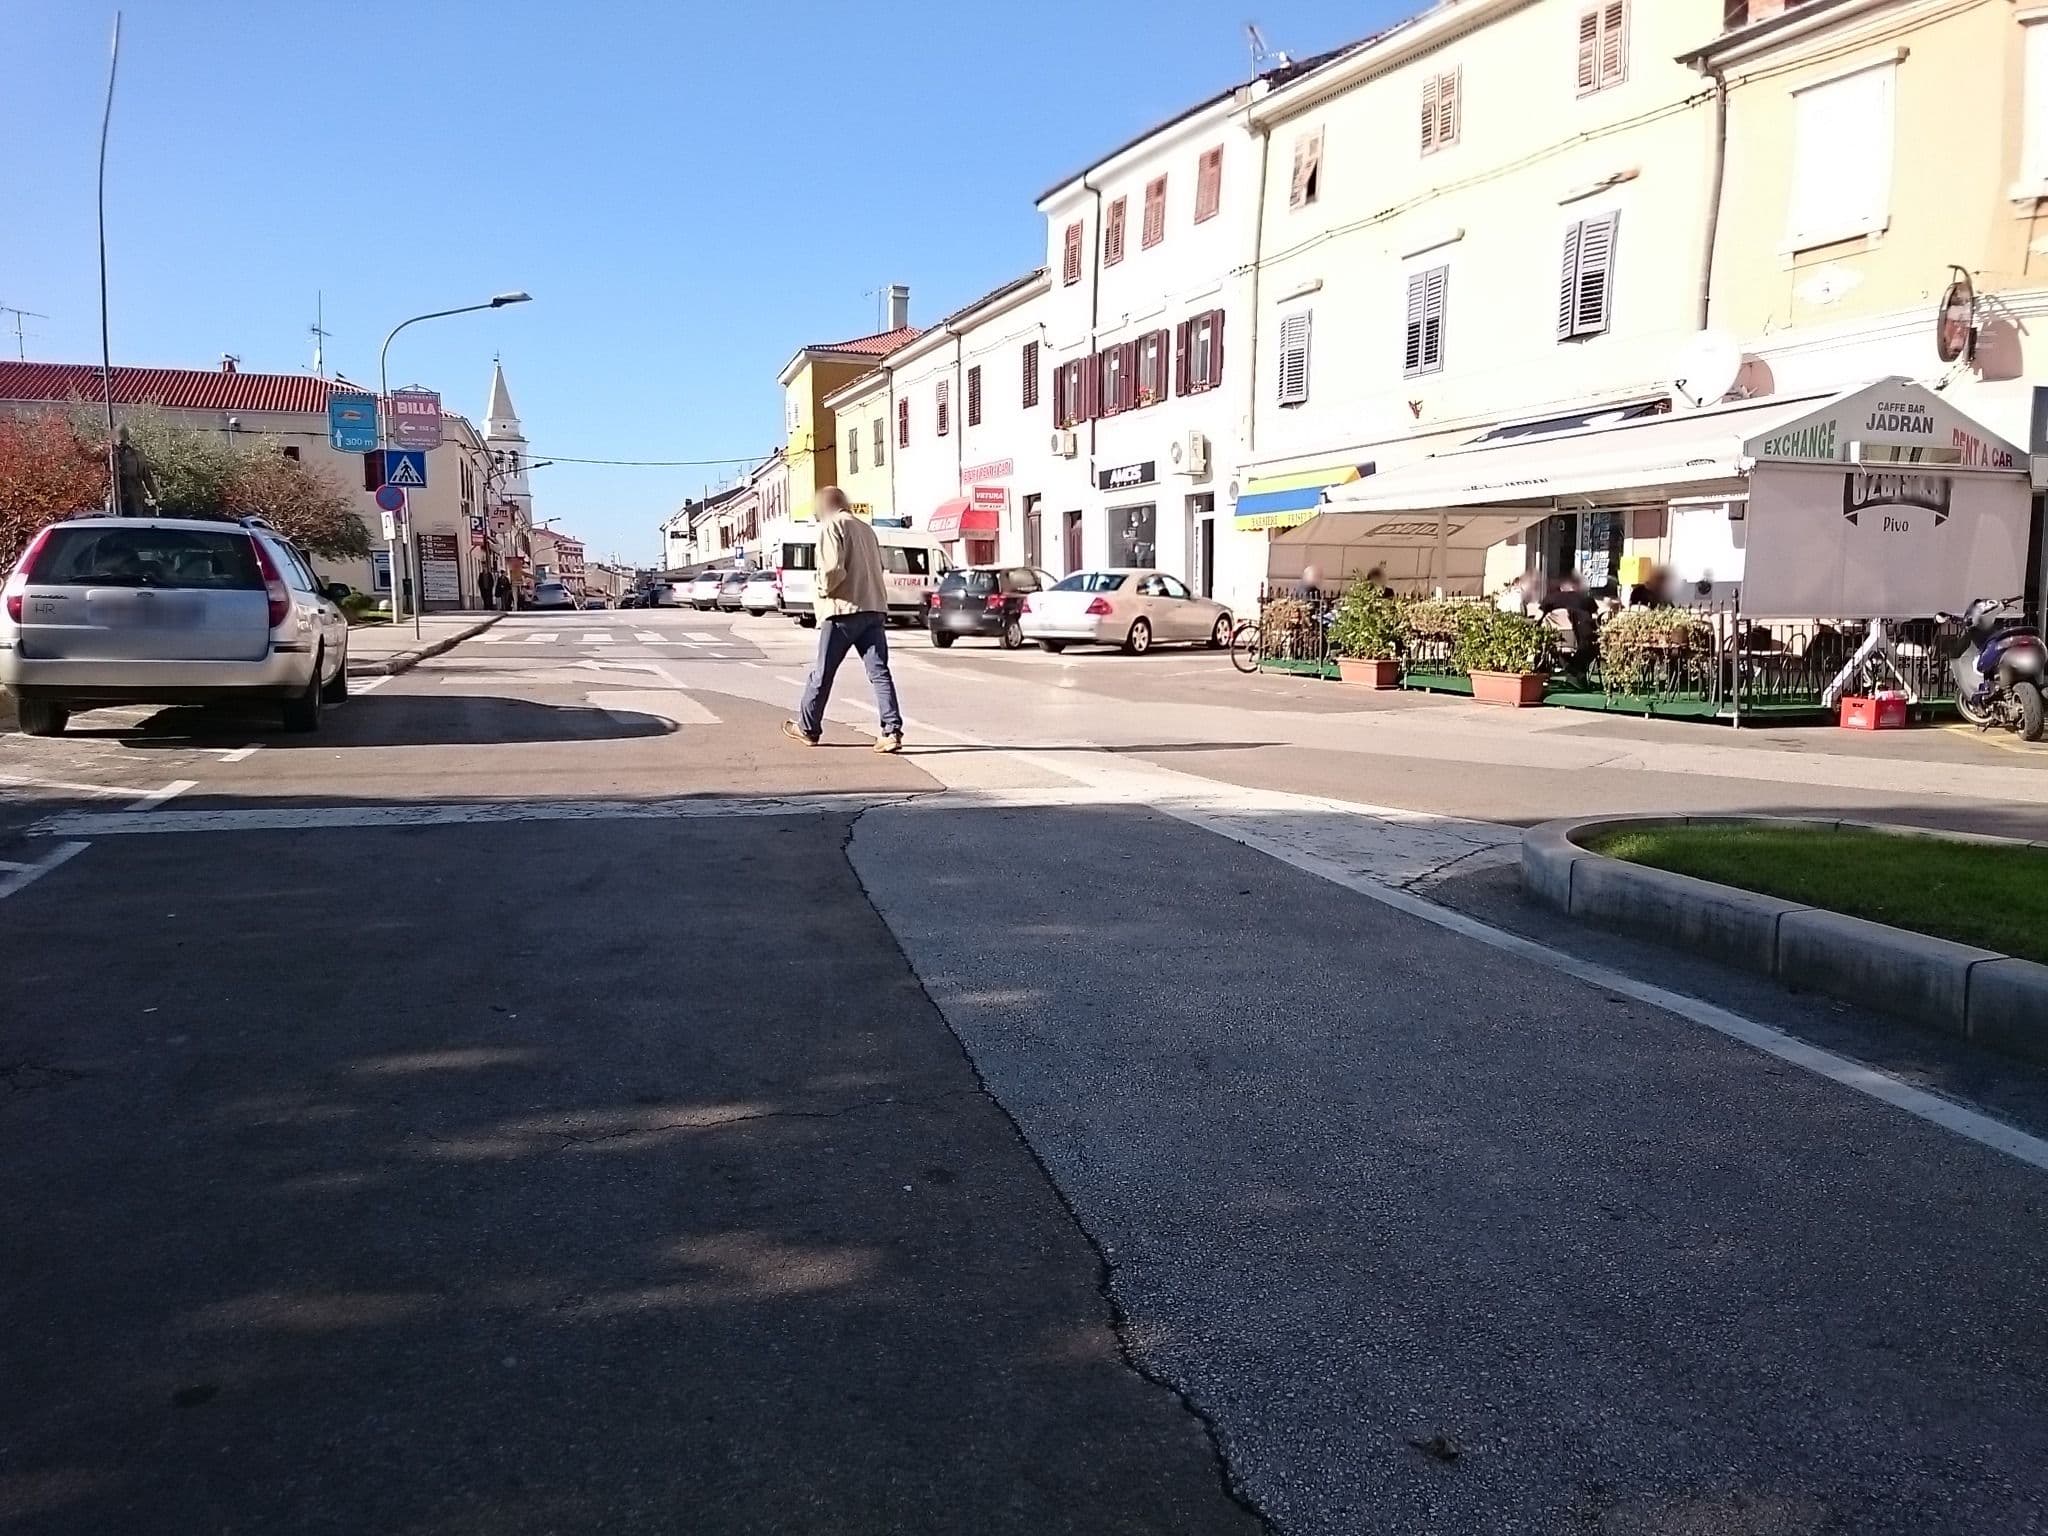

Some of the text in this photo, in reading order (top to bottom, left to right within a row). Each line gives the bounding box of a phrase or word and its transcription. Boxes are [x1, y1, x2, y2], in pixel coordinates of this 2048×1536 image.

[396, 402, 437, 415] BILLA
[1878, 401, 1926, 414] CAFFE BAR
[1866, 413, 1934, 434] JADRAN
[345, 438, 362, 446] 300
[1764, 419, 1837, 459] EXCHANGE
[1952, 428, 2014, 468] RENT A CAR
[493, 507, 508, 515] dm
[471, 518, 479, 529] P
[1883, 515, 1909, 533] Pivo
[894, 577, 921, 586] VETURA
[34, 603, 56, 615] HR
